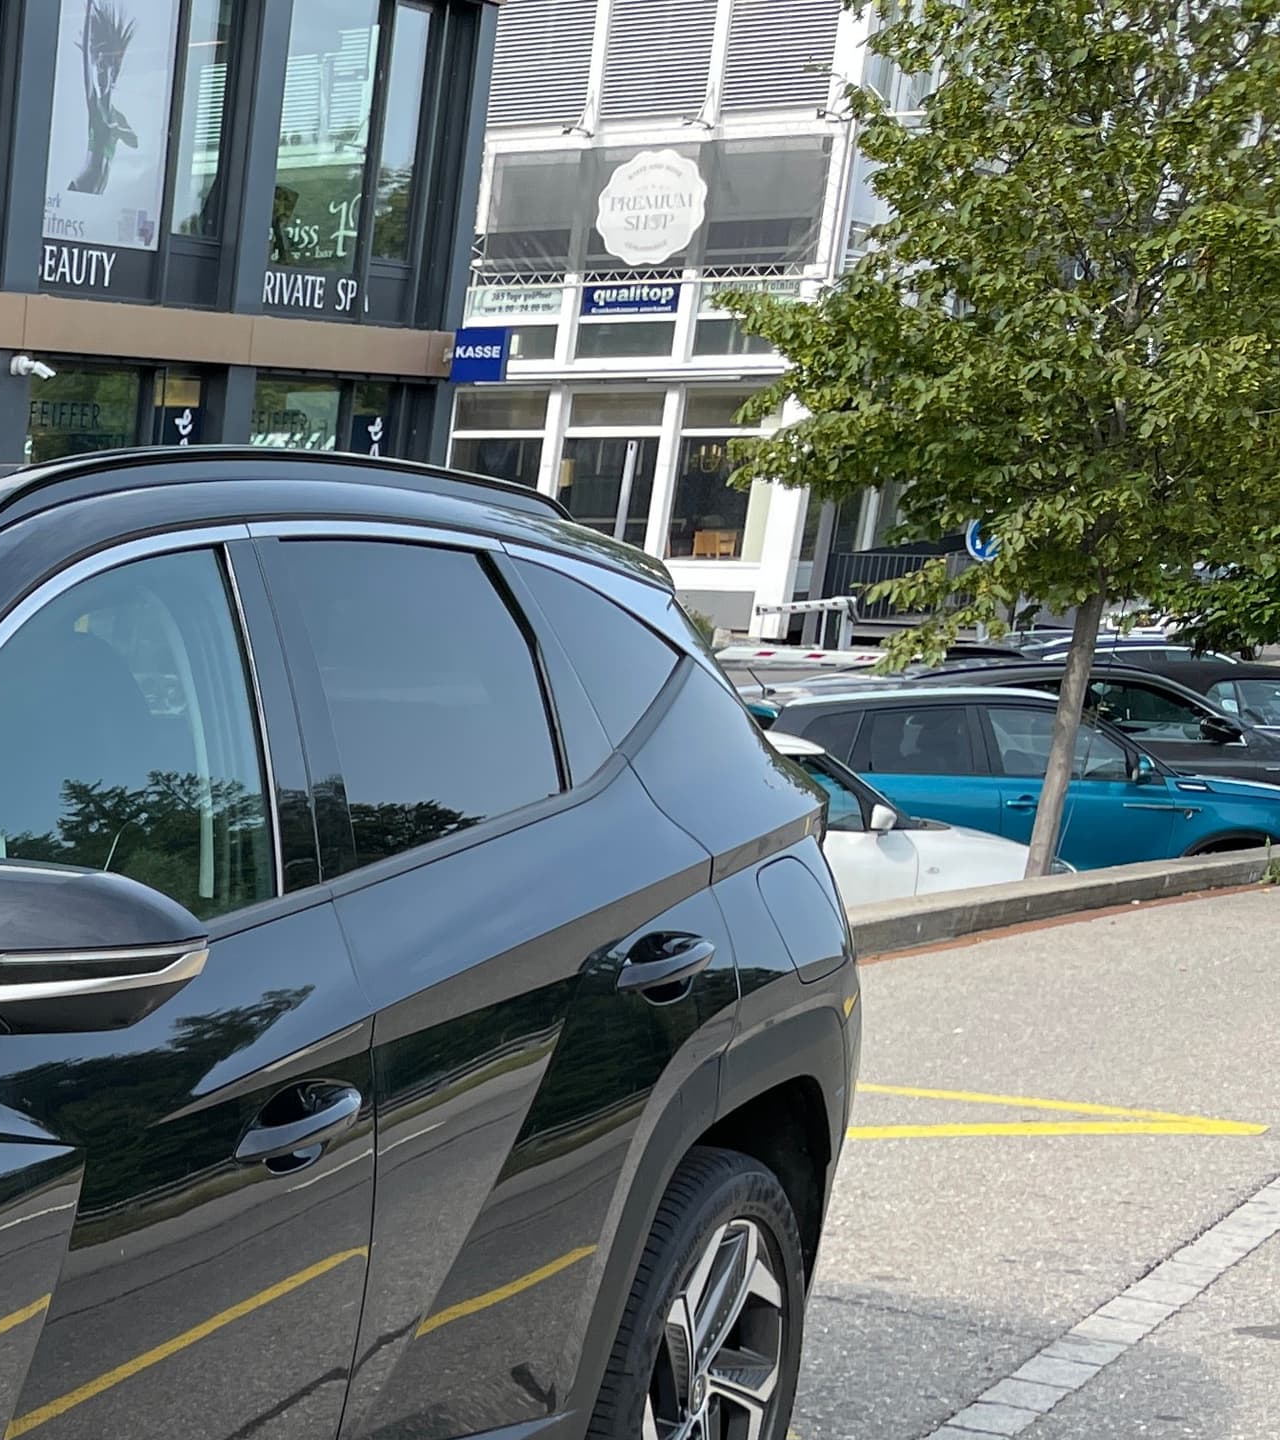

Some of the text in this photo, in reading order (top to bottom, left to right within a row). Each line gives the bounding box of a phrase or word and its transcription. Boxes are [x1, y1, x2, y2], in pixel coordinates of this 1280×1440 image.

[609, 193, 692, 212] PREMIUM
[624, 214, 675, 231] SHOP
[39, 244, 117, 288] EAUTY
[593, 285, 675, 307] qualitop
[455, 345, 502, 359] KASSE
